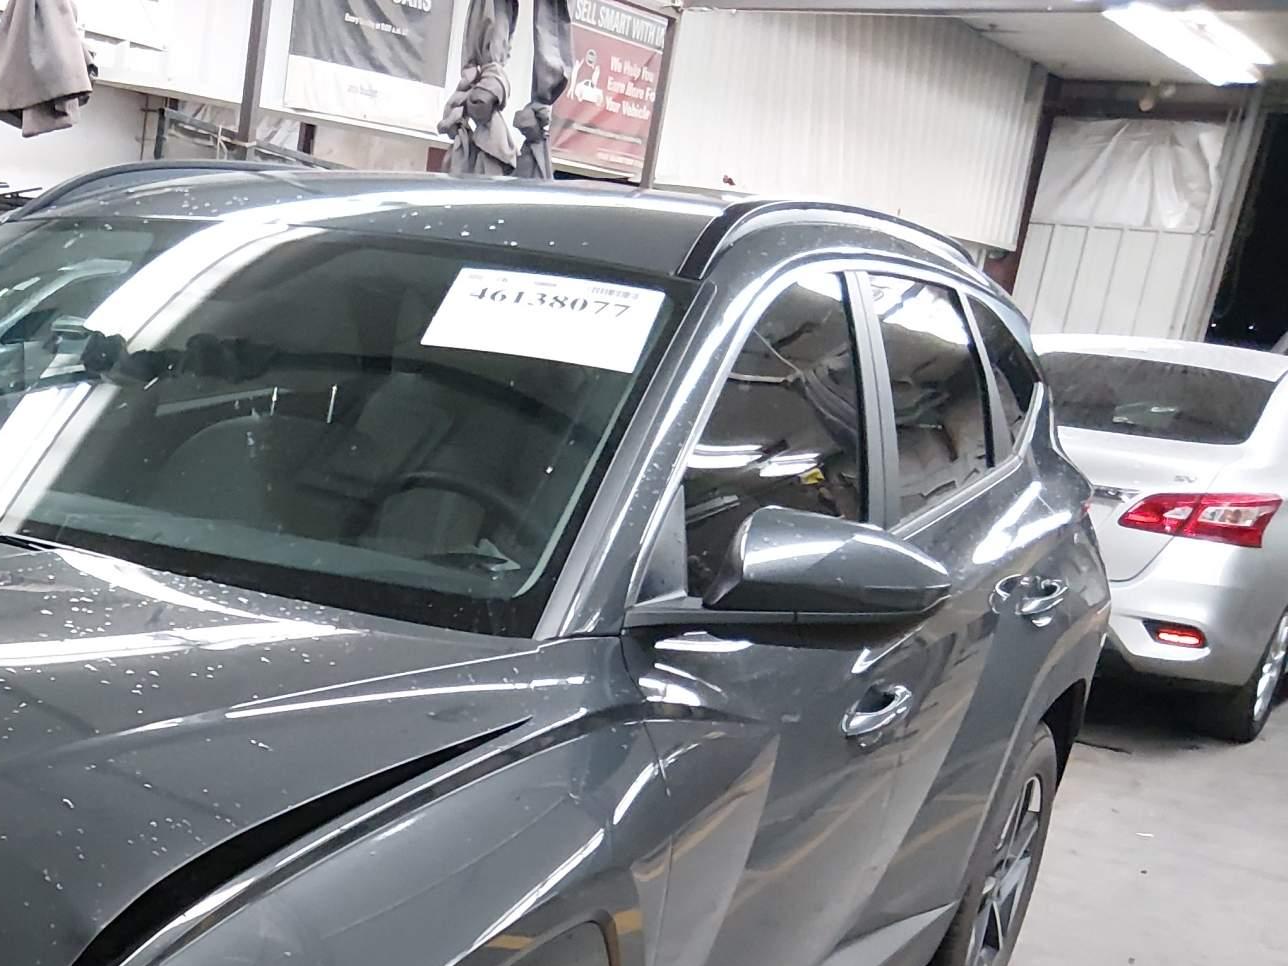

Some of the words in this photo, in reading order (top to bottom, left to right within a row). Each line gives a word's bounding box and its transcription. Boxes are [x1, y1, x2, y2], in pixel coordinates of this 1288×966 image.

[576, 0, 597, 25] SELL
[598, 6, 632, 36] SMART
[631, 17, 655, 45] WITH
[645, 87, 656, 102] Fo
[469, 287, 631, 318] 46138077
